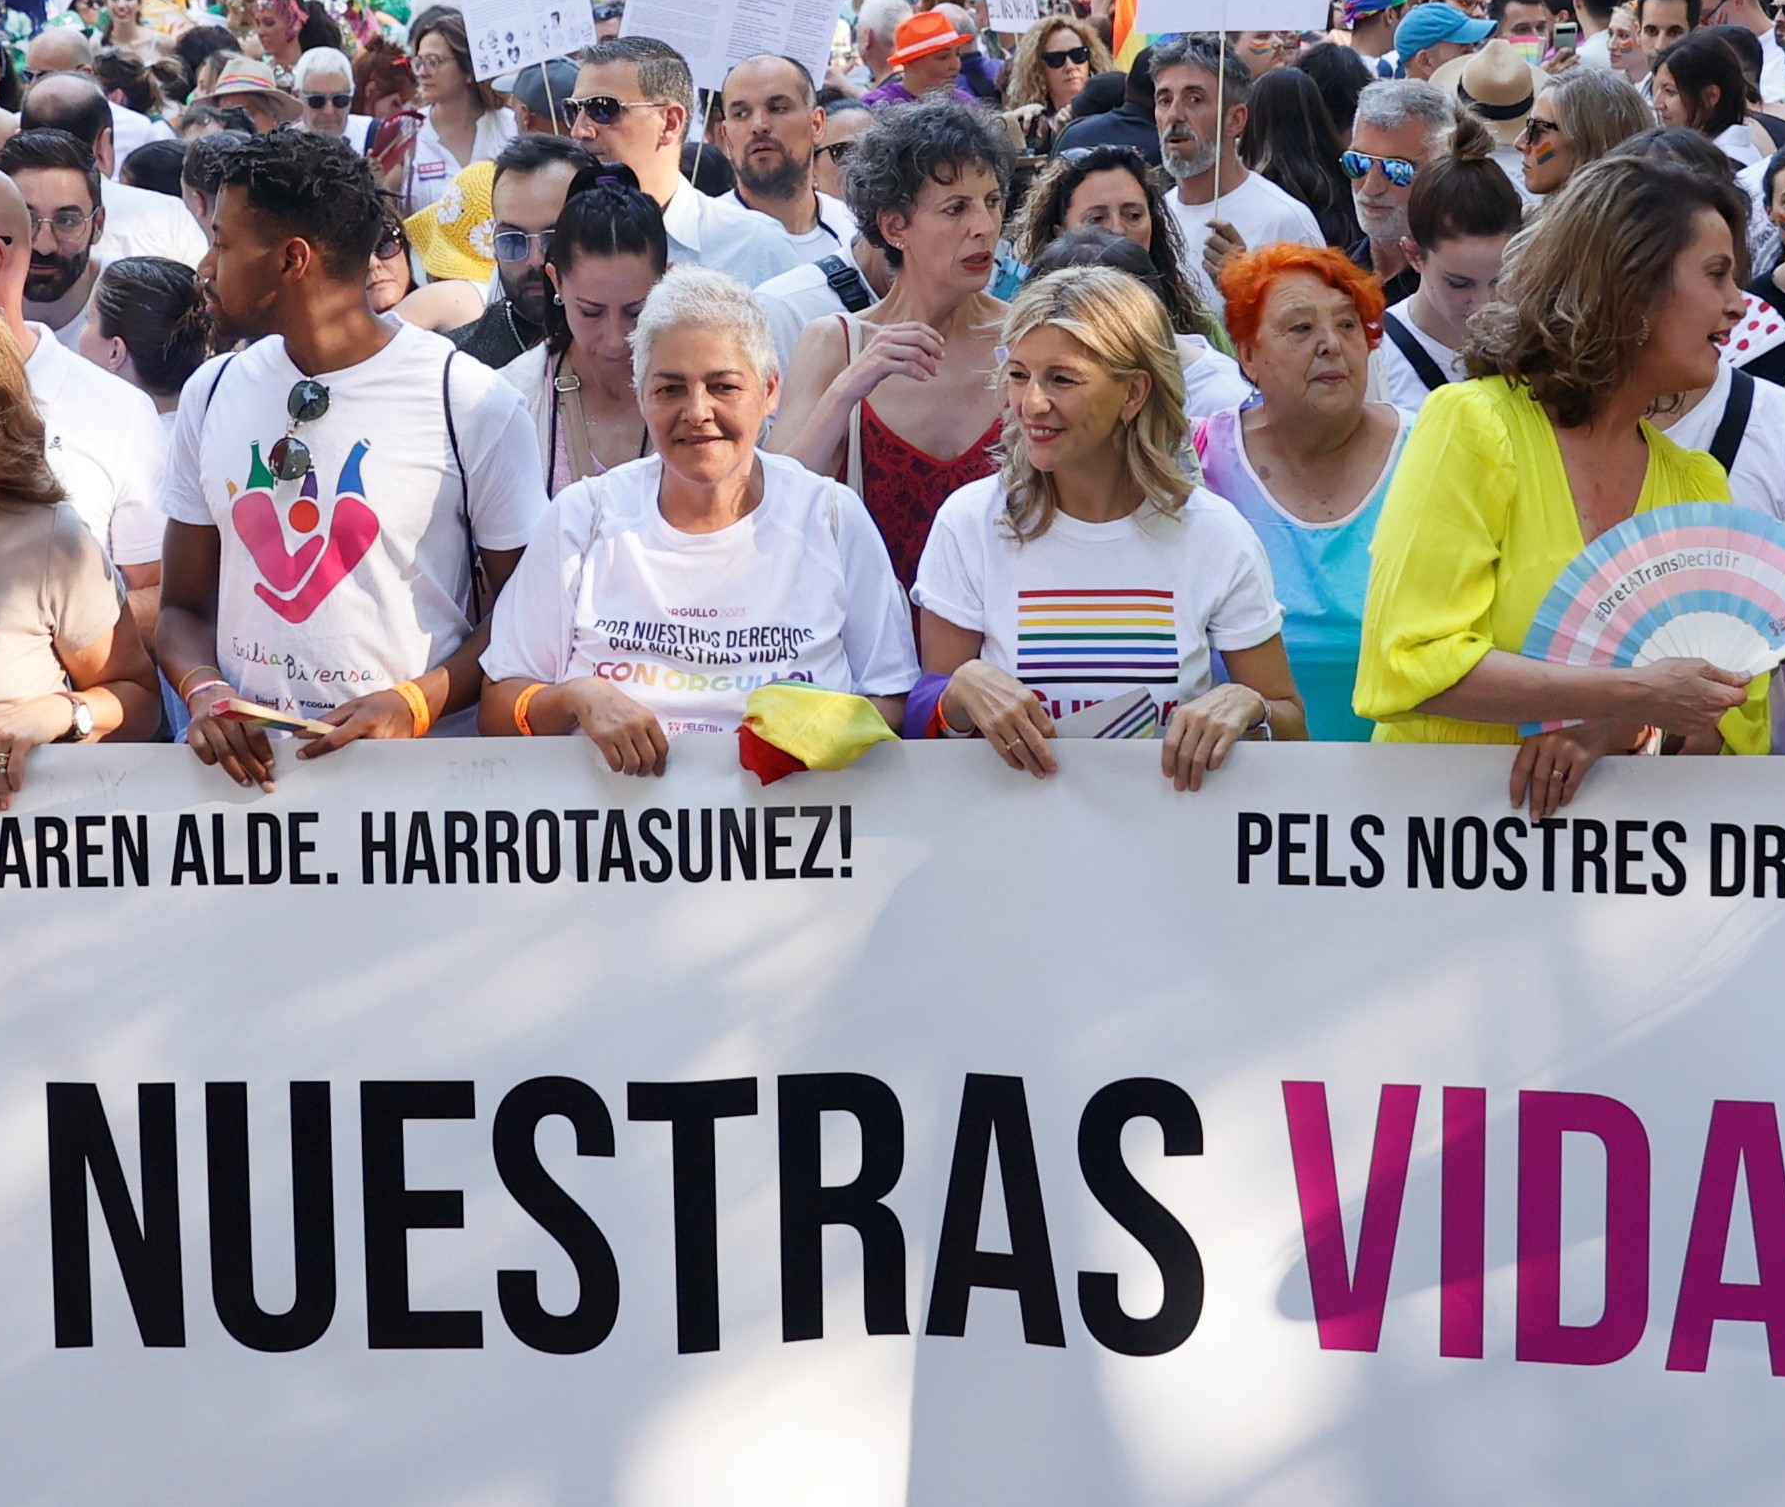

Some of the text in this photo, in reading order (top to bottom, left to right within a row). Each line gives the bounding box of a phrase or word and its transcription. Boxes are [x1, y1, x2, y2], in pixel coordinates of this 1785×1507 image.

[1593, 550, 1740, 624] #DretATransDecidir
[632, 620, 721, 649] NUESTROS
[725, 625, 816, 650] DERECHOS
[306, 700, 336, 710] COGAM
[171, 812, 338, 885] ALDE.
[362, 806, 852, 884] HARROTASUNEZ!
[1238, 813, 1384, 888] PELS
[1408, 815, 1686, 896] NOSTRES
[46, 1073, 1204, 1356] NUESTRAS
